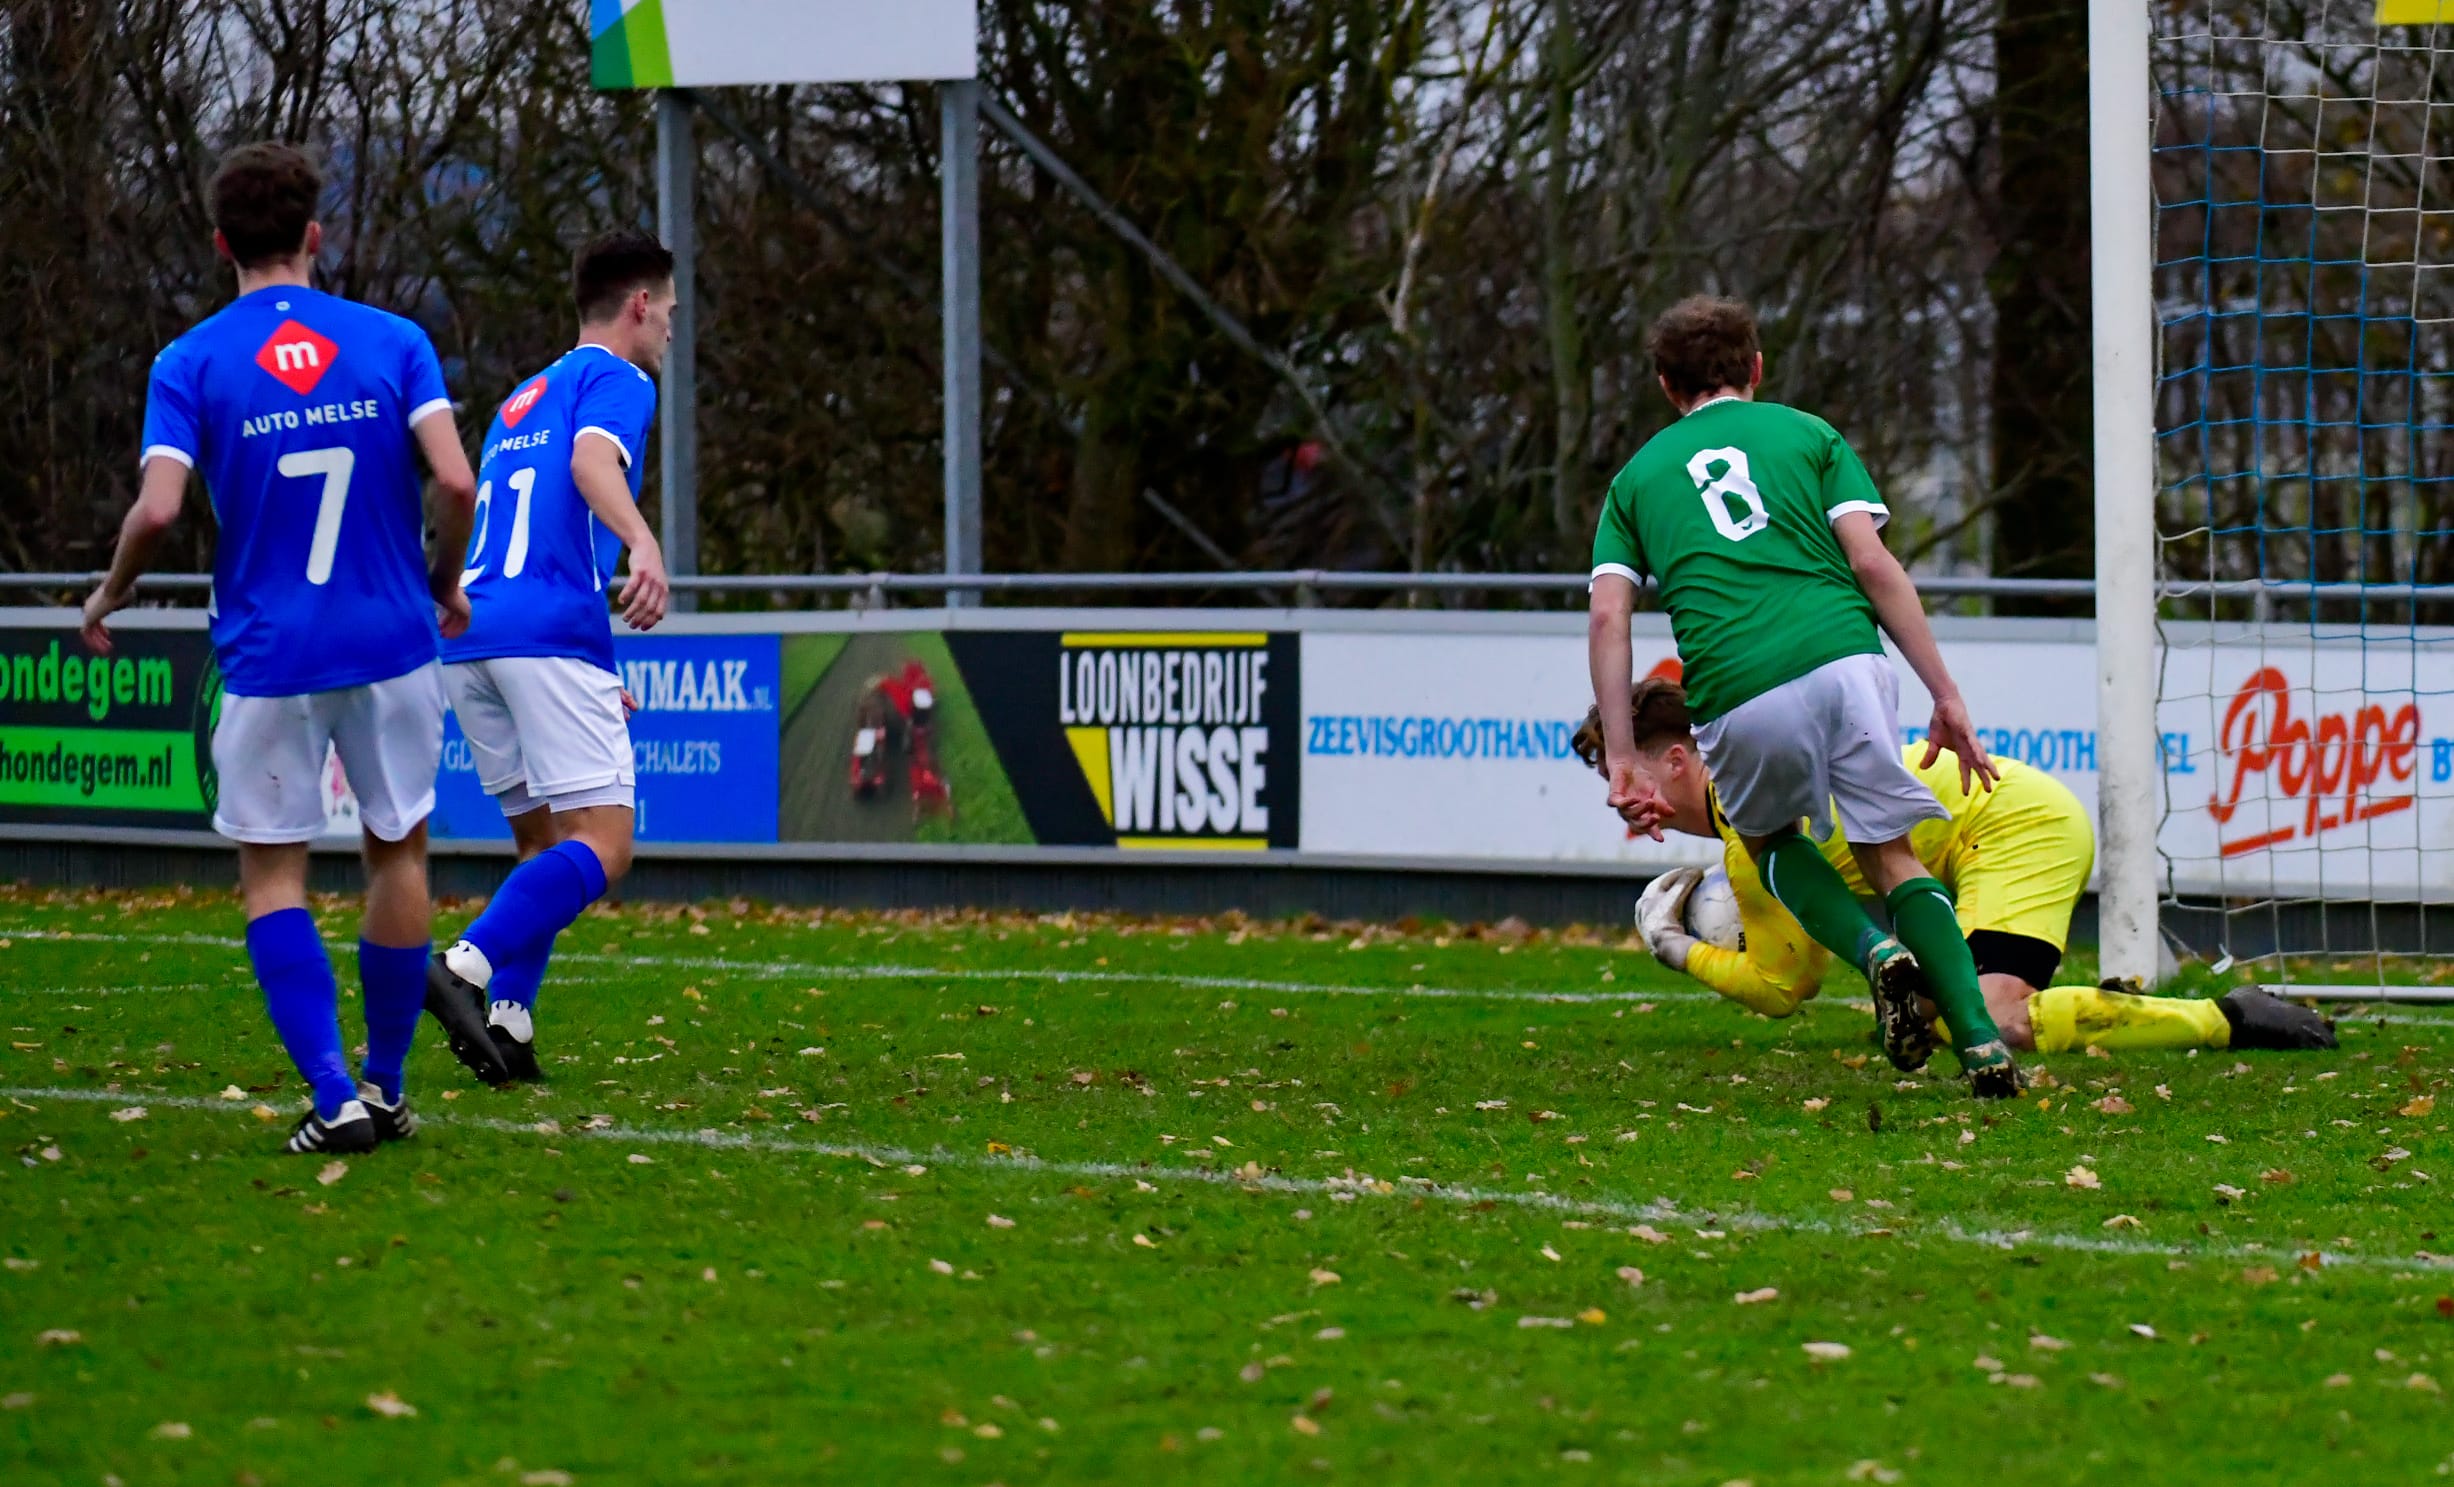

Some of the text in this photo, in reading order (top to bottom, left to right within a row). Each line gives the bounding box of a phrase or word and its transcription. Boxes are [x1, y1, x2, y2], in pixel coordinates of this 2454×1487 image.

[274, 341, 319, 371] m
[242, 400, 379, 438] AUTO MELSE
[499, 429, 550, 452] MELSE
[277, 446, 355, 586] 7
[458, 467, 536, 587] 21
[1686, 446, 1770, 542] 8
[1060, 651, 1268, 724] LOONBEDRIJF
[633, 740, 721, 774] CHALETS
[1109, 726, 1268, 833] WISSE
[2209, 666, 2420, 837] Poppe
